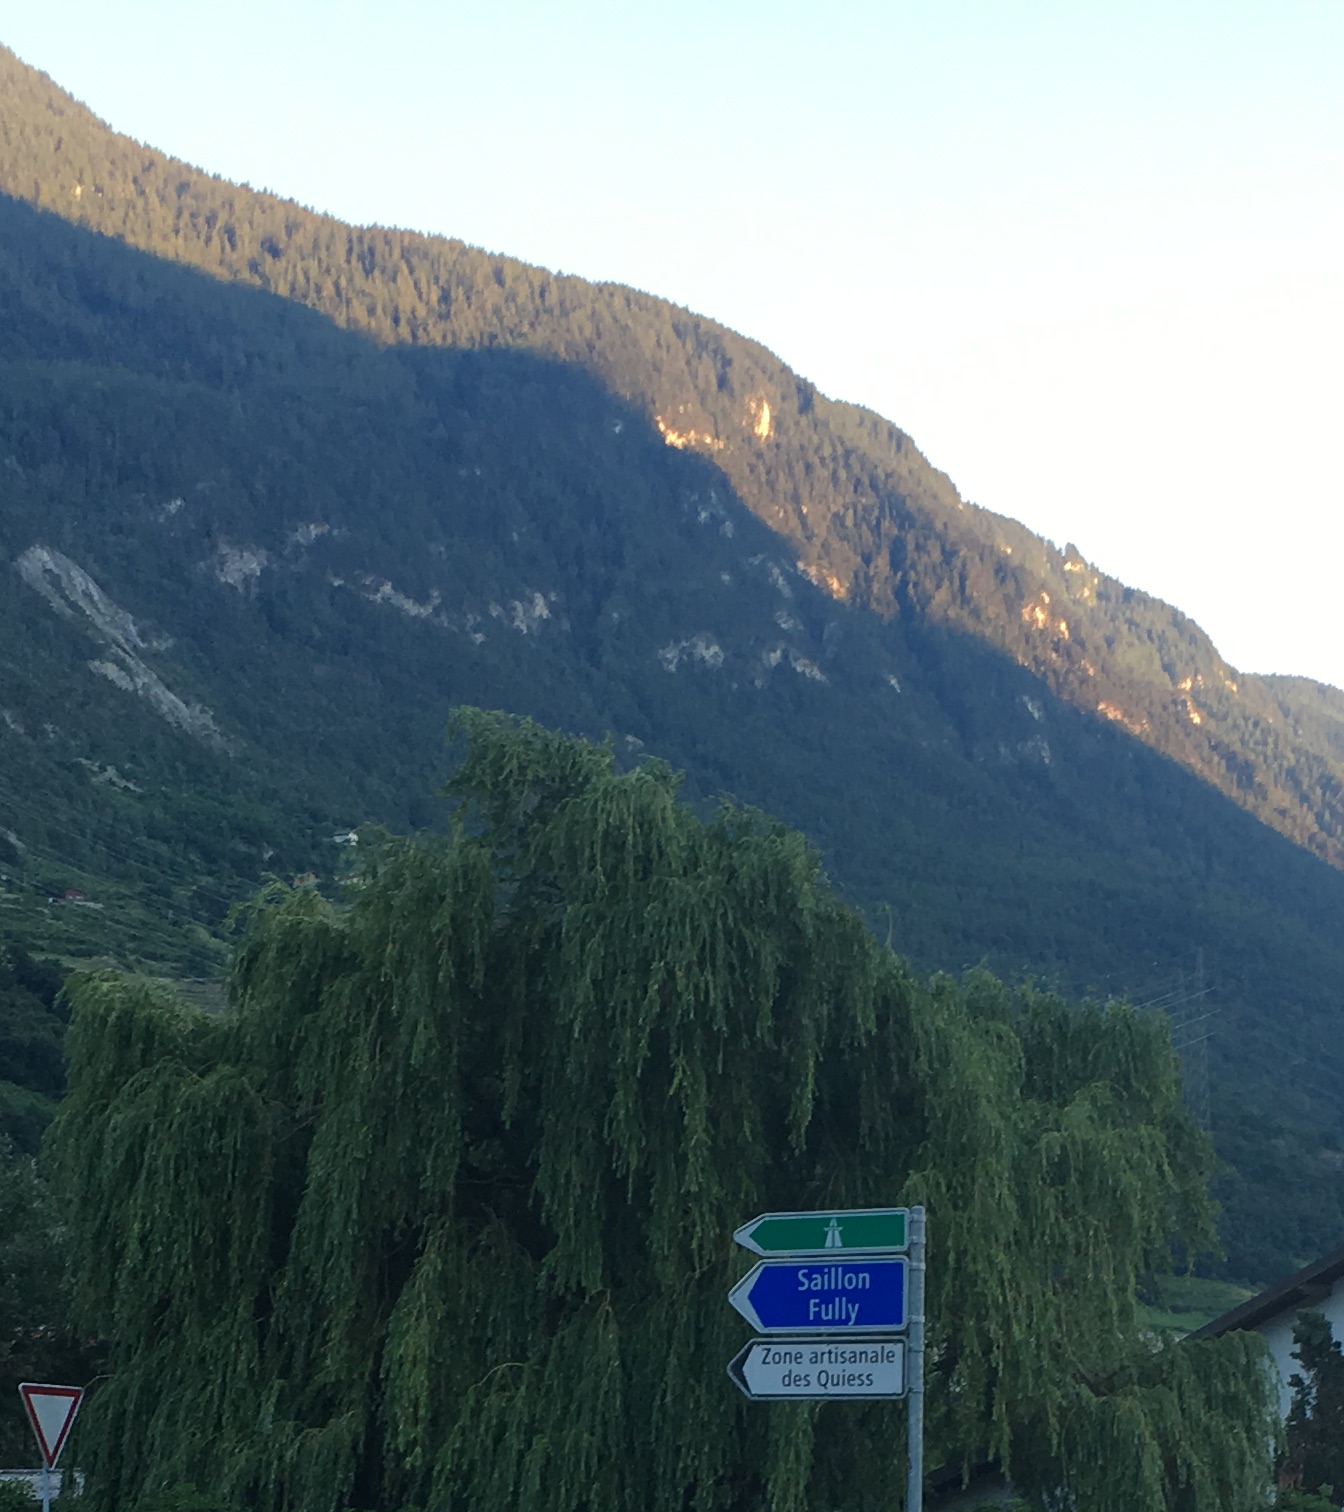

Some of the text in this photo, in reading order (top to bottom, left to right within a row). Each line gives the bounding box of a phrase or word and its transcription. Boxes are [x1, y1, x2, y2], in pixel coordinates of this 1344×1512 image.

[797, 1267, 871, 1291] Saillon
[808, 1297, 860, 1326] Fully
[761, 1345, 896, 1365] Zone artisanale
[781, 1369, 874, 1388] des Quiess
